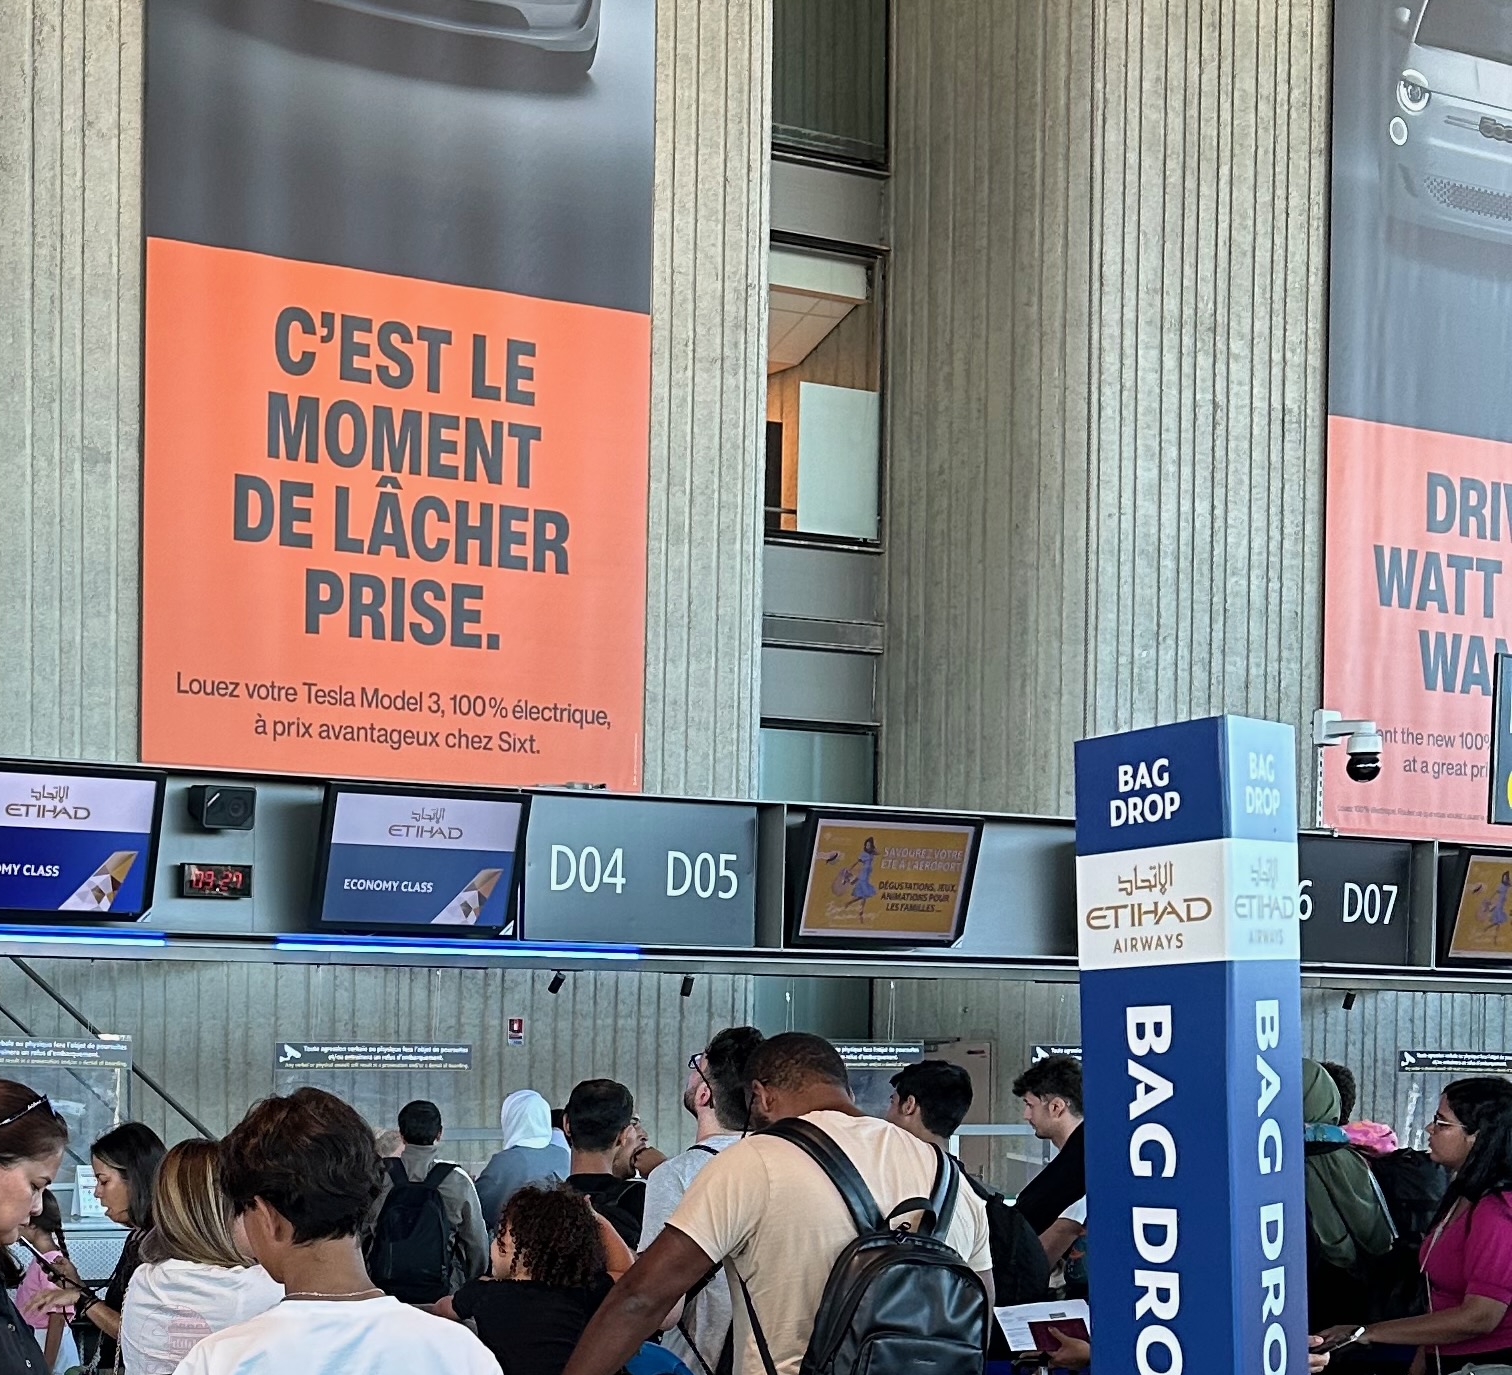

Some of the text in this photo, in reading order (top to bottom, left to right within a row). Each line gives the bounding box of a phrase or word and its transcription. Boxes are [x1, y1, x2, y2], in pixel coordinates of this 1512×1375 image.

[275, 306, 536, 406] C'EST LE
[267, 391, 541, 488] MOMENT
[233, 474, 570, 575] DE LÂCHER
[1374, 544, 1502, 618] WATT
[305, 568, 500, 650] PRISE.
[1418, 629, 1511, 697] WA
[177, 672, 239, 699] Louez
[245, 680, 297, 702] votre
[303, 682, 355, 707] Tesla
[360, 687, 423, 712] Model
[428, 692, 446, 718] 3,
[512, 698, 611, 728] électrique,
[255, 713, 540, 755] à prix avantageux chez Sixt.
[1401, 728, 1424, 746] the
[1428, 733, 1456, 749] new
[1118, 757, 1170, 793] BAG
[1249, 752, 1275, 783] BAG
[1403, 756, 1418, 773] at
[1420, 760, 1429, 774] a
[1432, 759, 1468, 780] great
[5, 802, 91, 820] ETIHAD
[1110, 791, 1181, 828] DROP
[1245, 786, 1280, 816] DROP
[388, 824, 464, 841] ETIHAD
[23, 863, 60, 878] CLASS
[343, 878, 433, 894] ECONOMY CLASS
[550, 844, 738, 899] D04 D05
[1086, 896, 1213, 930] ETIHAD
[1235, 894, 1295, 920] ETIHAD
[1343, 882, 1398, 925] D07
[1113, 933, 1184, 954] AIRWAYS
[1126, 1005, 1176, 1179] BAG
[1256, 999, 1283, 1175] BAG
